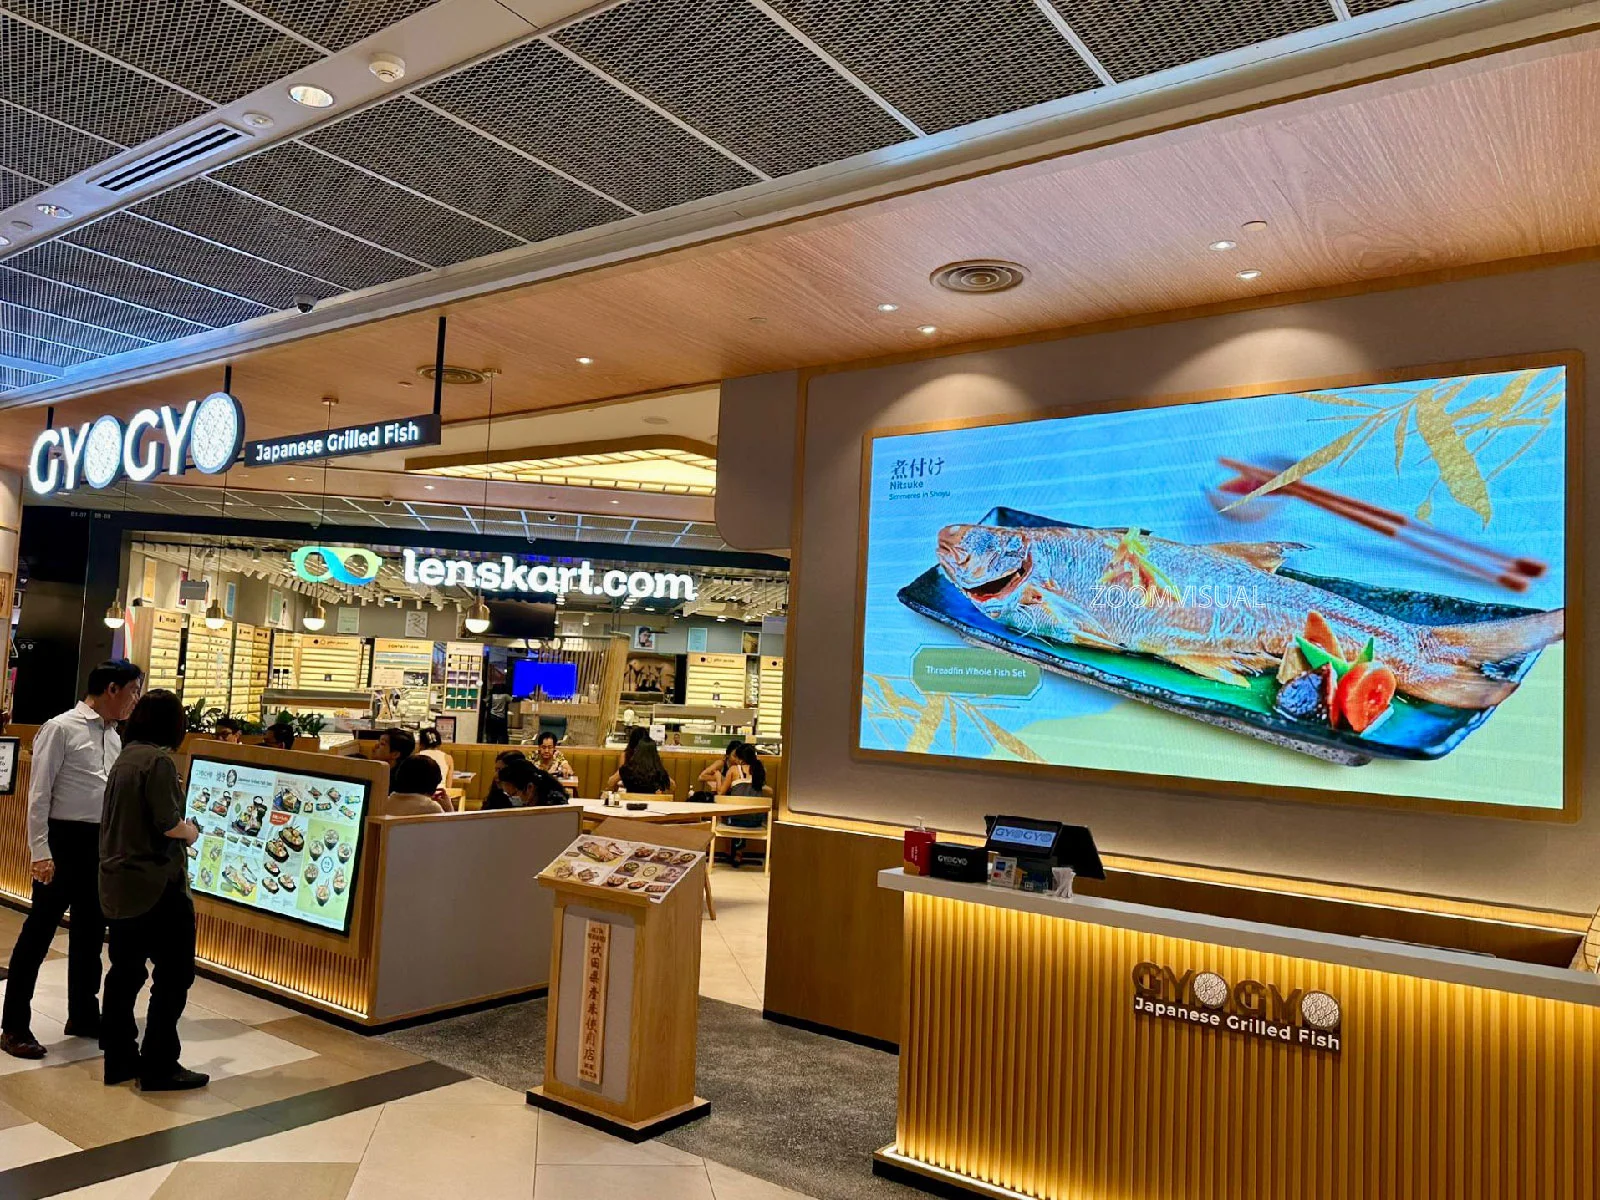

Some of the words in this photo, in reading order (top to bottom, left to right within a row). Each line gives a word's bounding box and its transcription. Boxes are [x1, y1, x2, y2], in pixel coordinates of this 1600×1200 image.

[30, 391, 241, 495] GYOGYO
[255, 439, 323, 464] Japanese
[326, 429, 380, 452] Grilled
[384, 421, 420, 444] Fish
[890, 480, 924, 490] Nitsuke
[891, 457, 945, 480] 煮付け
[930, 490, 950, 498] Shoyu
[403, 549, 697, 600] lenskart.com
[925, 665, 963, 675] Threadfin
[966, 667, 992, 676] Whole
[994, 668, 1010, 677] Fish
[1012, 669, 1027, 678] Set
[995, 827, 1053, 842] GYOGYO
[1132, 962, 1341, 1029] GYOGYO
[1135, 997, 1220, 1025] Japanese
[1227, 1016, 1290, 1040] Grilled
[1299, 1030, 1340, 1050] Fish
